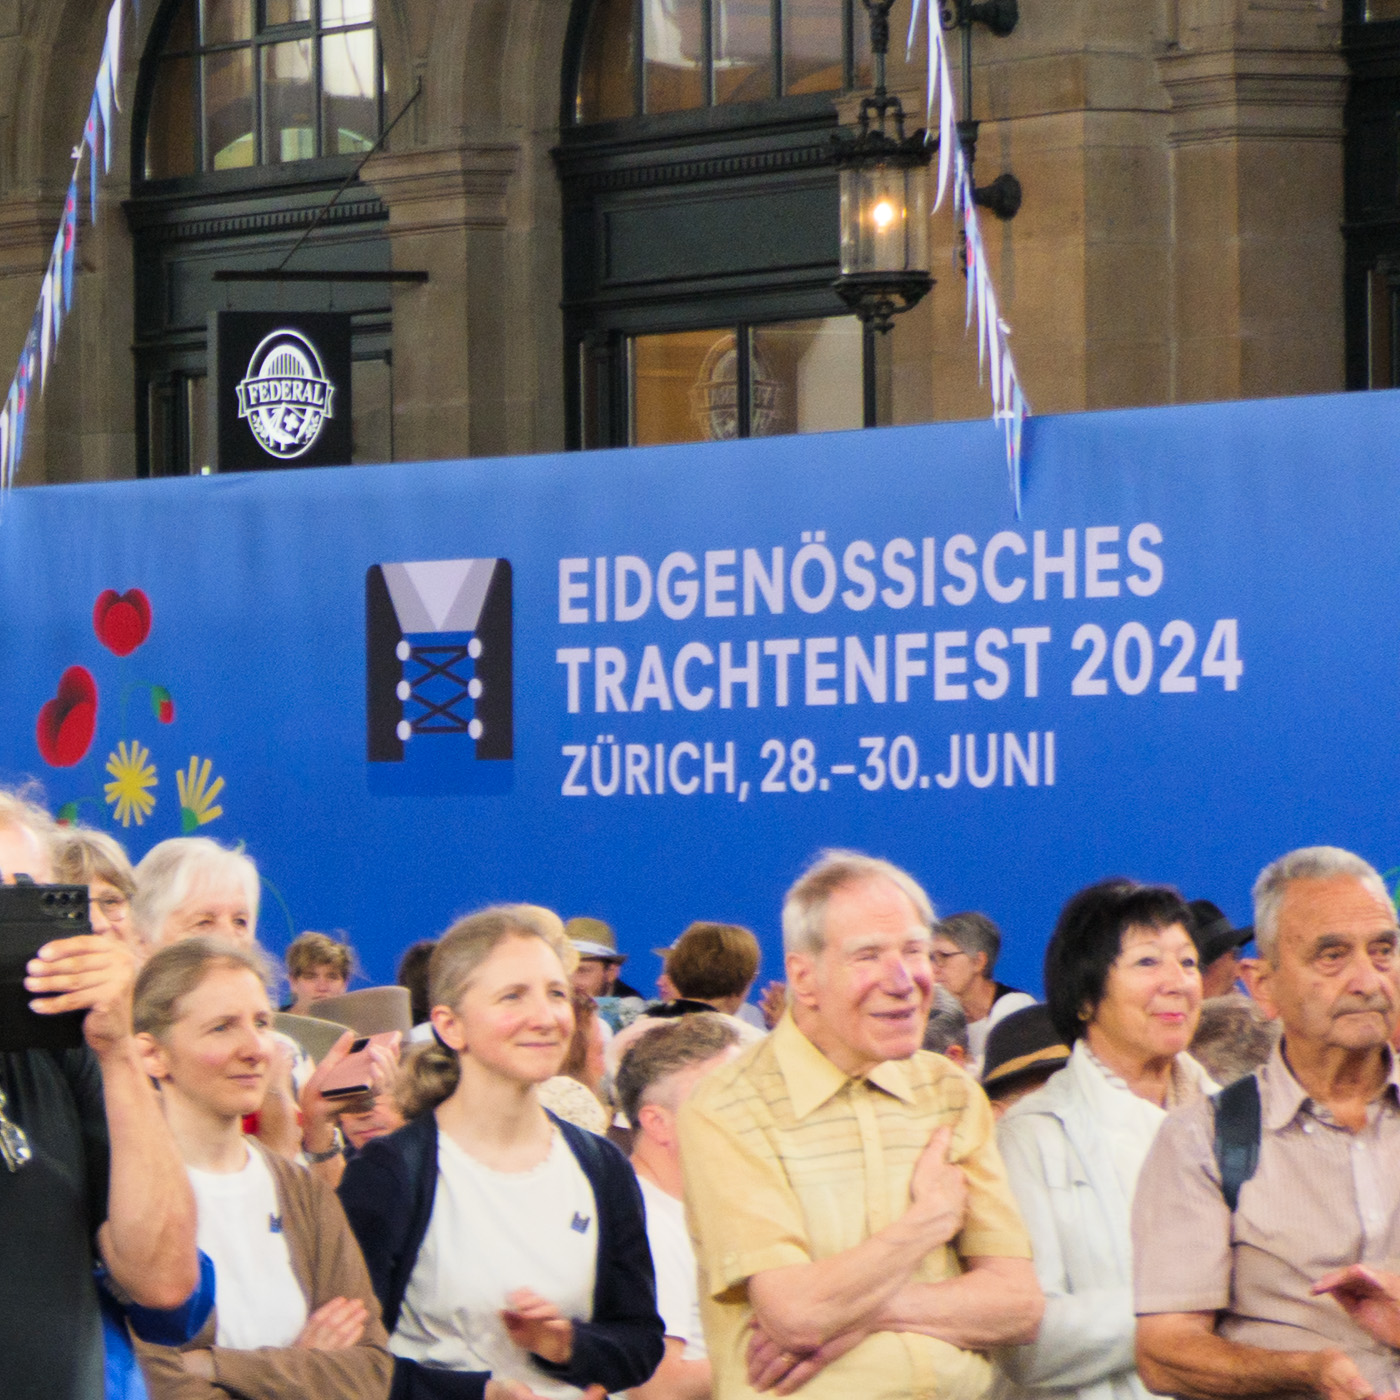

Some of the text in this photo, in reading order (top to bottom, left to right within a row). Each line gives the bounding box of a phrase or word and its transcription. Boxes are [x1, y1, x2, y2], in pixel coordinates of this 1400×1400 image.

[247, 379, 324, 405] FEDERAL
[558, 522, 1164, 624] EIDGENÖSSISCHES
[555, 618, 1243, 713] TRACHTENFEST 2024
[561, 734, 750, 803] ZÜRICH,
